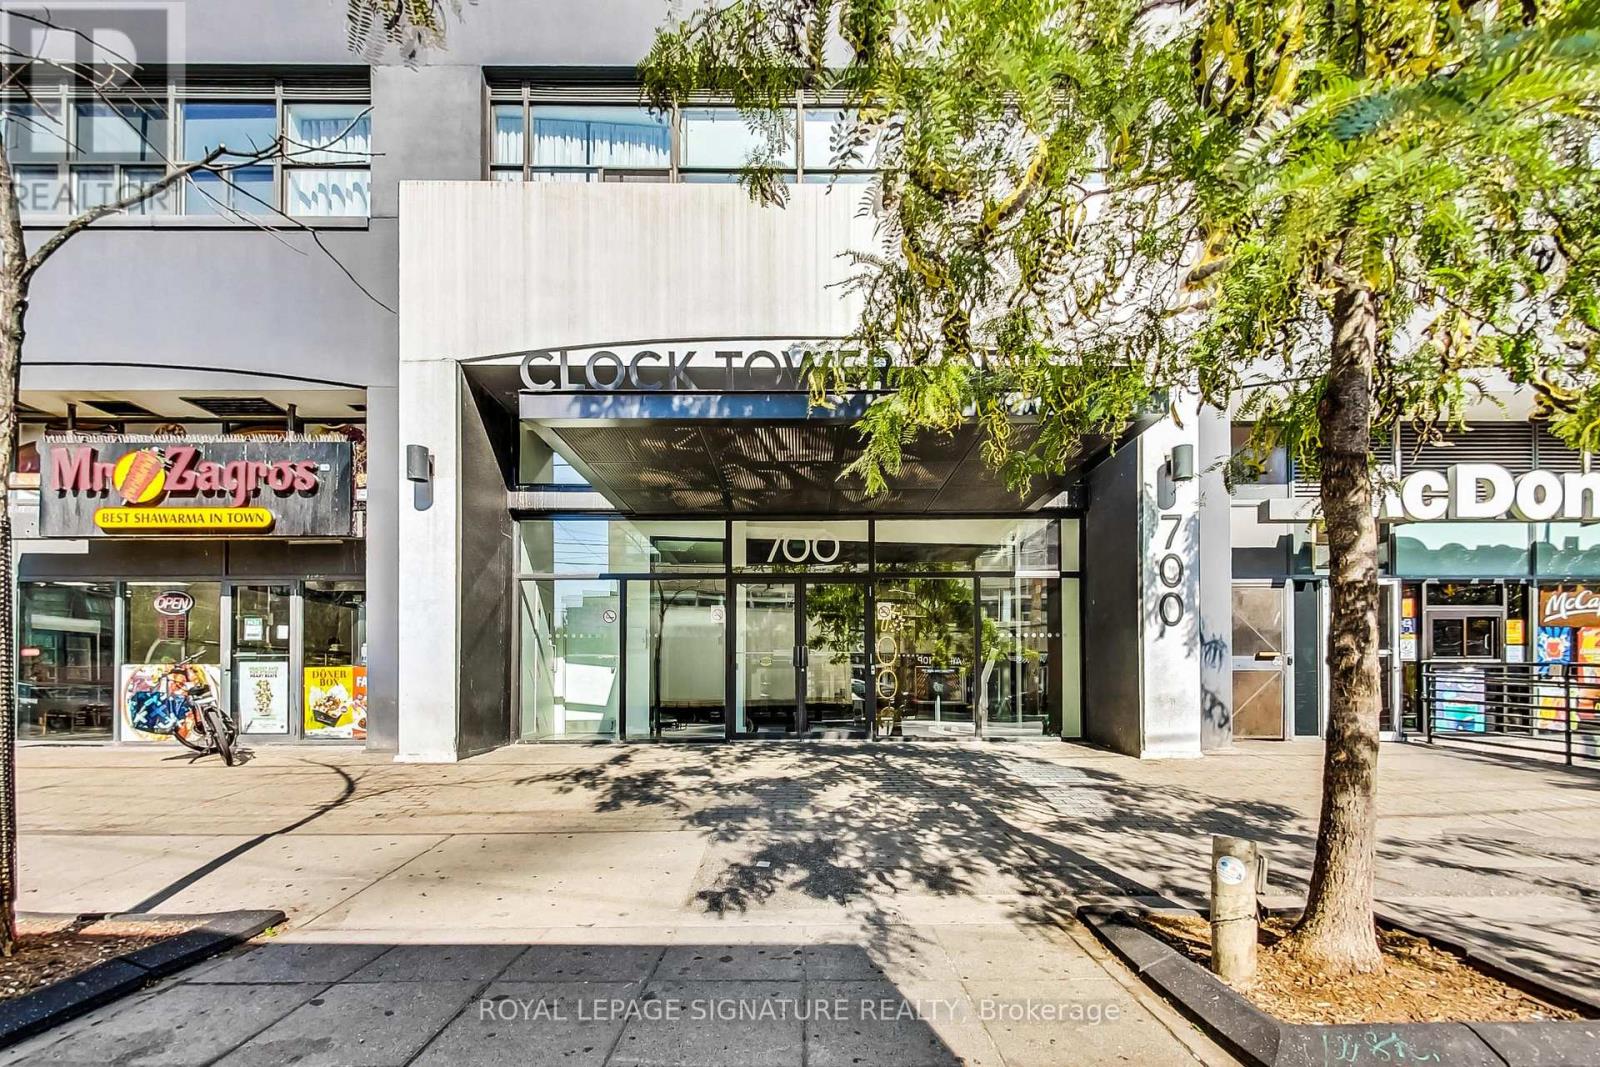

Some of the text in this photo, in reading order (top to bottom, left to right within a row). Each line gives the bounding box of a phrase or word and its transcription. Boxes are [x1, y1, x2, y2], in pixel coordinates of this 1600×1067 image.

[519, 350, 701, 390] CLOCK
[52, 446, 321, 507] Mr Zagros
[101, 512, 265, 524] BEST SHAWARMA IN TOWN
[1159, 514, 1184, 627] 700
[158, 597, 189, 609] OPEN
[312, 669, 347, 679] DÖNER
[319, 678, 340, 687] BOX
